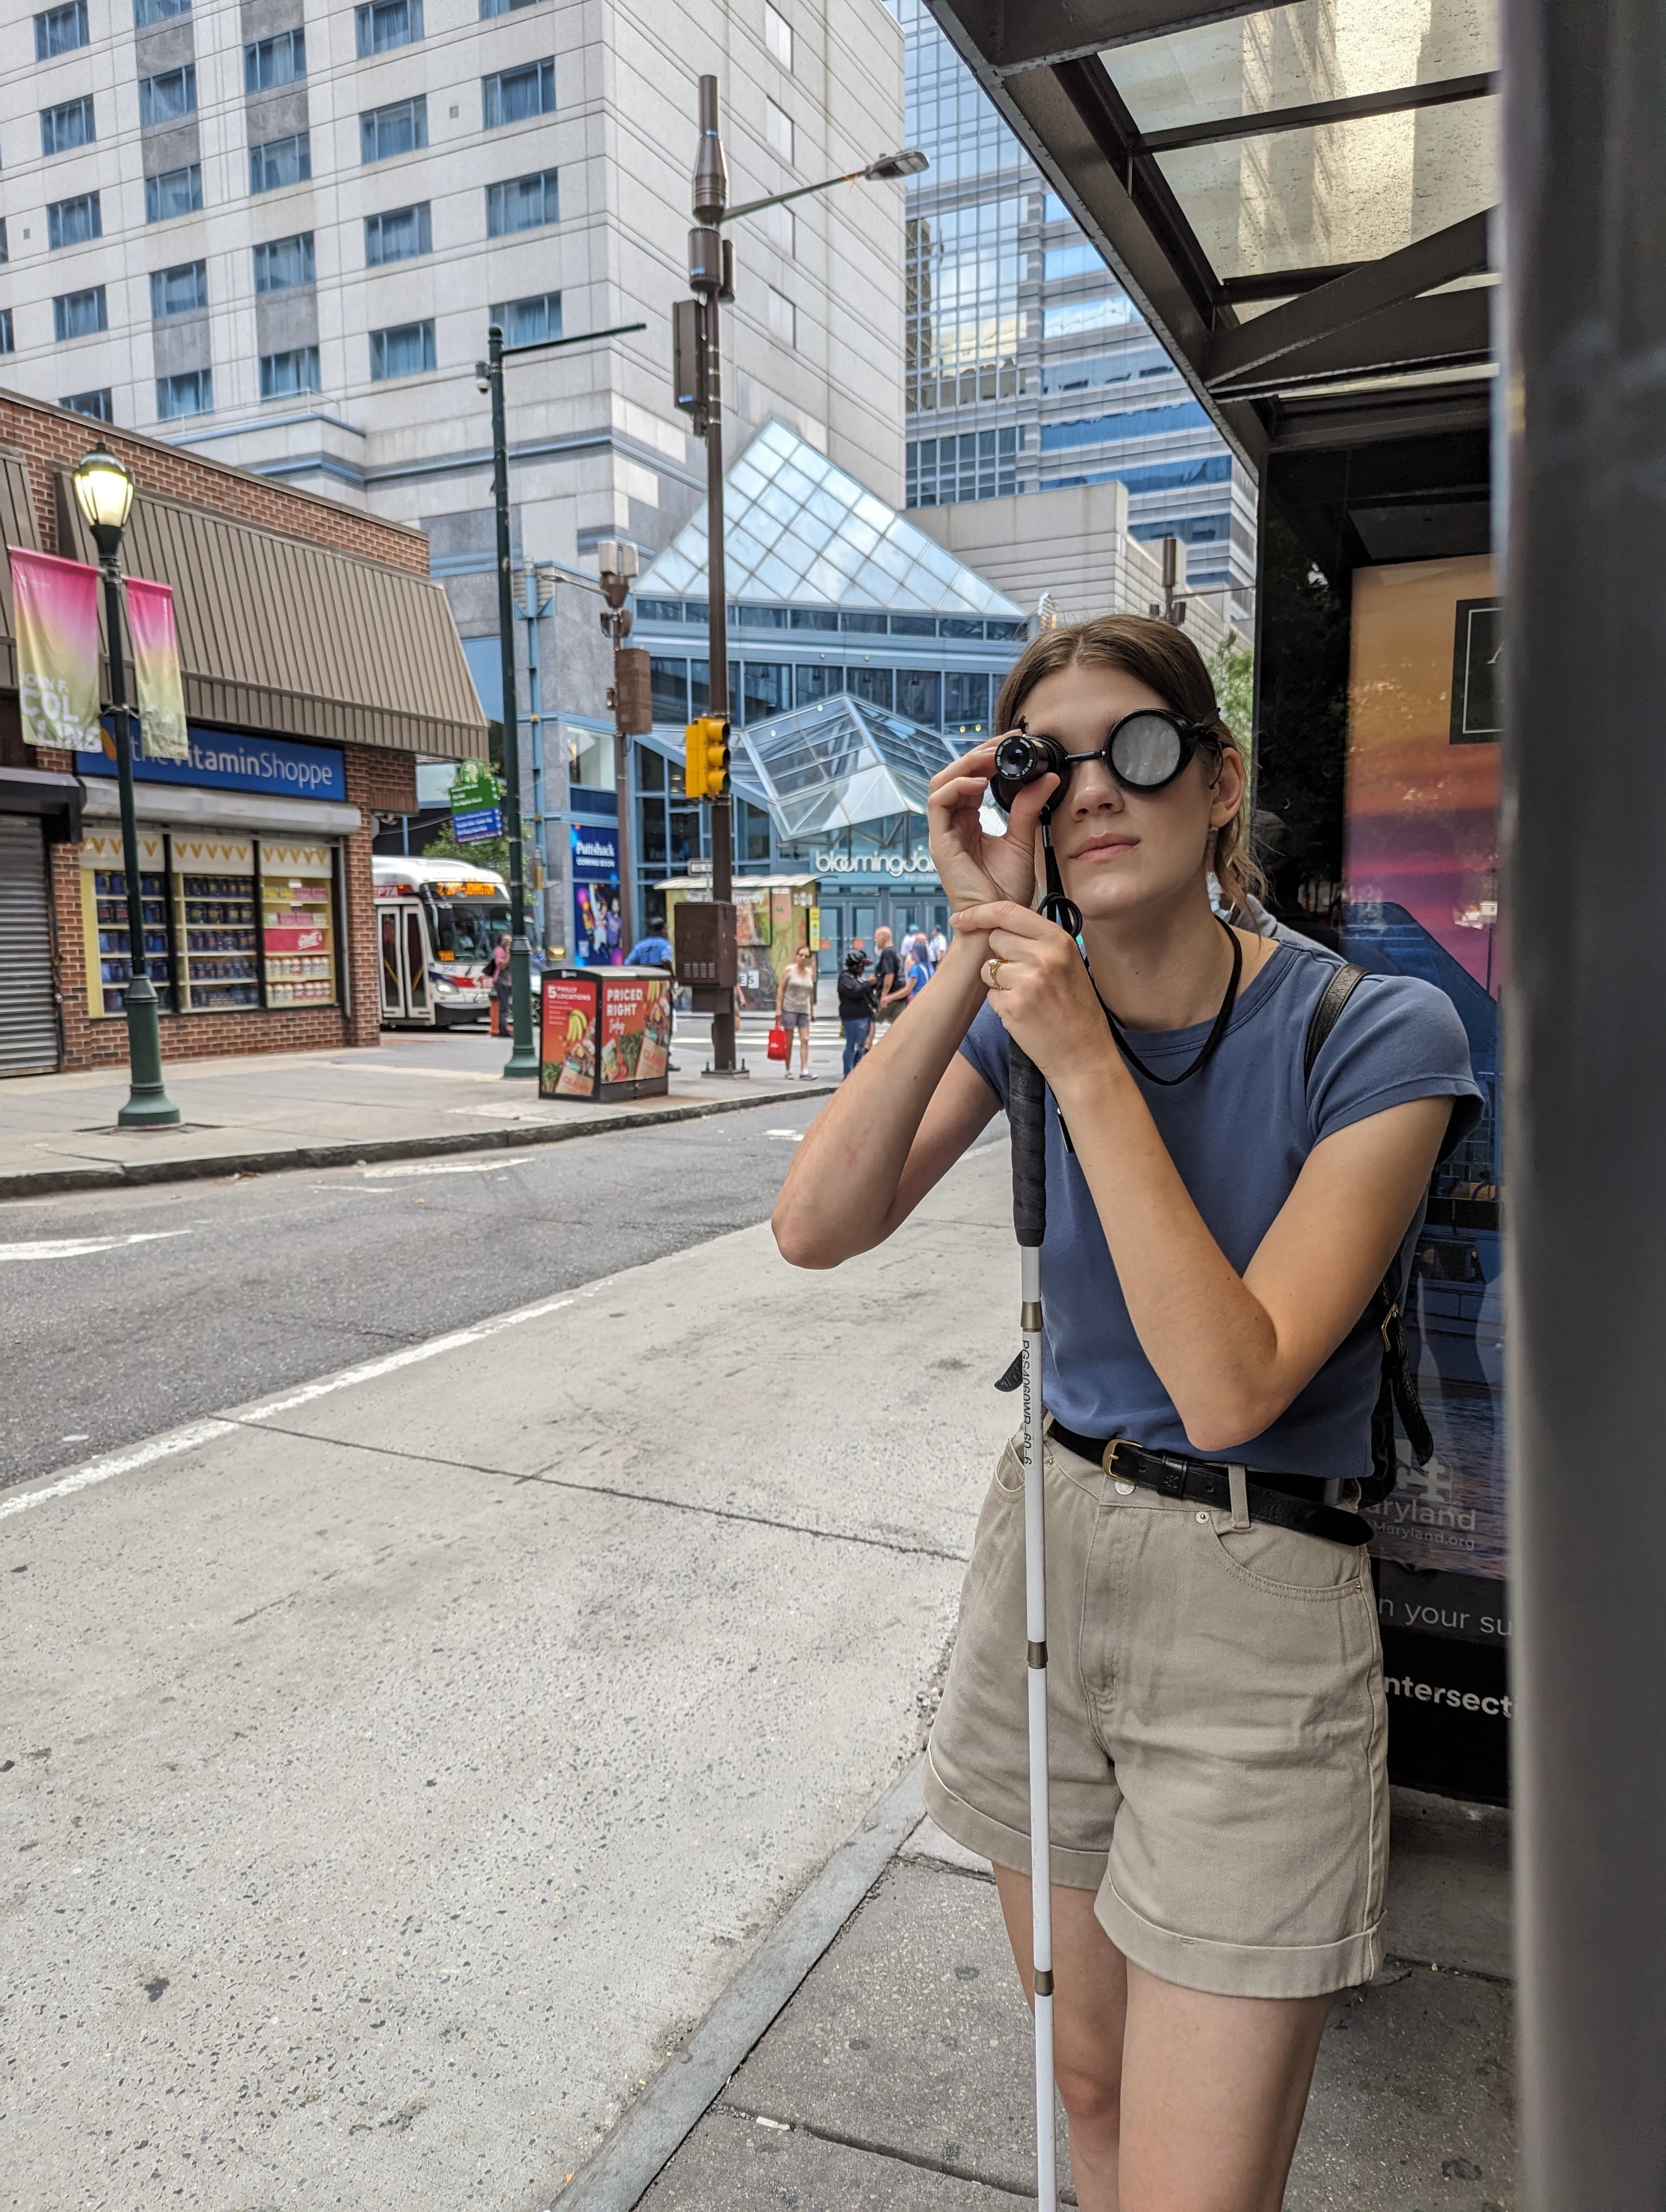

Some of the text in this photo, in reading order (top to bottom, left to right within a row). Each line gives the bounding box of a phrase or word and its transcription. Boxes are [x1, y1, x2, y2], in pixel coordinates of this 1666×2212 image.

[21, 688, 79, 724] COL
[576, 841, 615, 857] Puttshack
[816, 850, 937, 877] bloomingdal
[374, 886, 398, 898] EPTA
[547, 985, 558, 999] 5
[556, 993, 591, 1001] LOCATIONS
[607, 988, 643, 1002] PRICED
[606, 1003, 637, 1016] RIGHT
[1365, 1500, 1476, 1531] aryland
[1371, 1520, 1475, 1551] Maryland.org
[1405, 1602, 1470, 1629] your
[1480, 1616, 1513, 1637] su
[1384, 1675, 1515, 1719] ntersect
